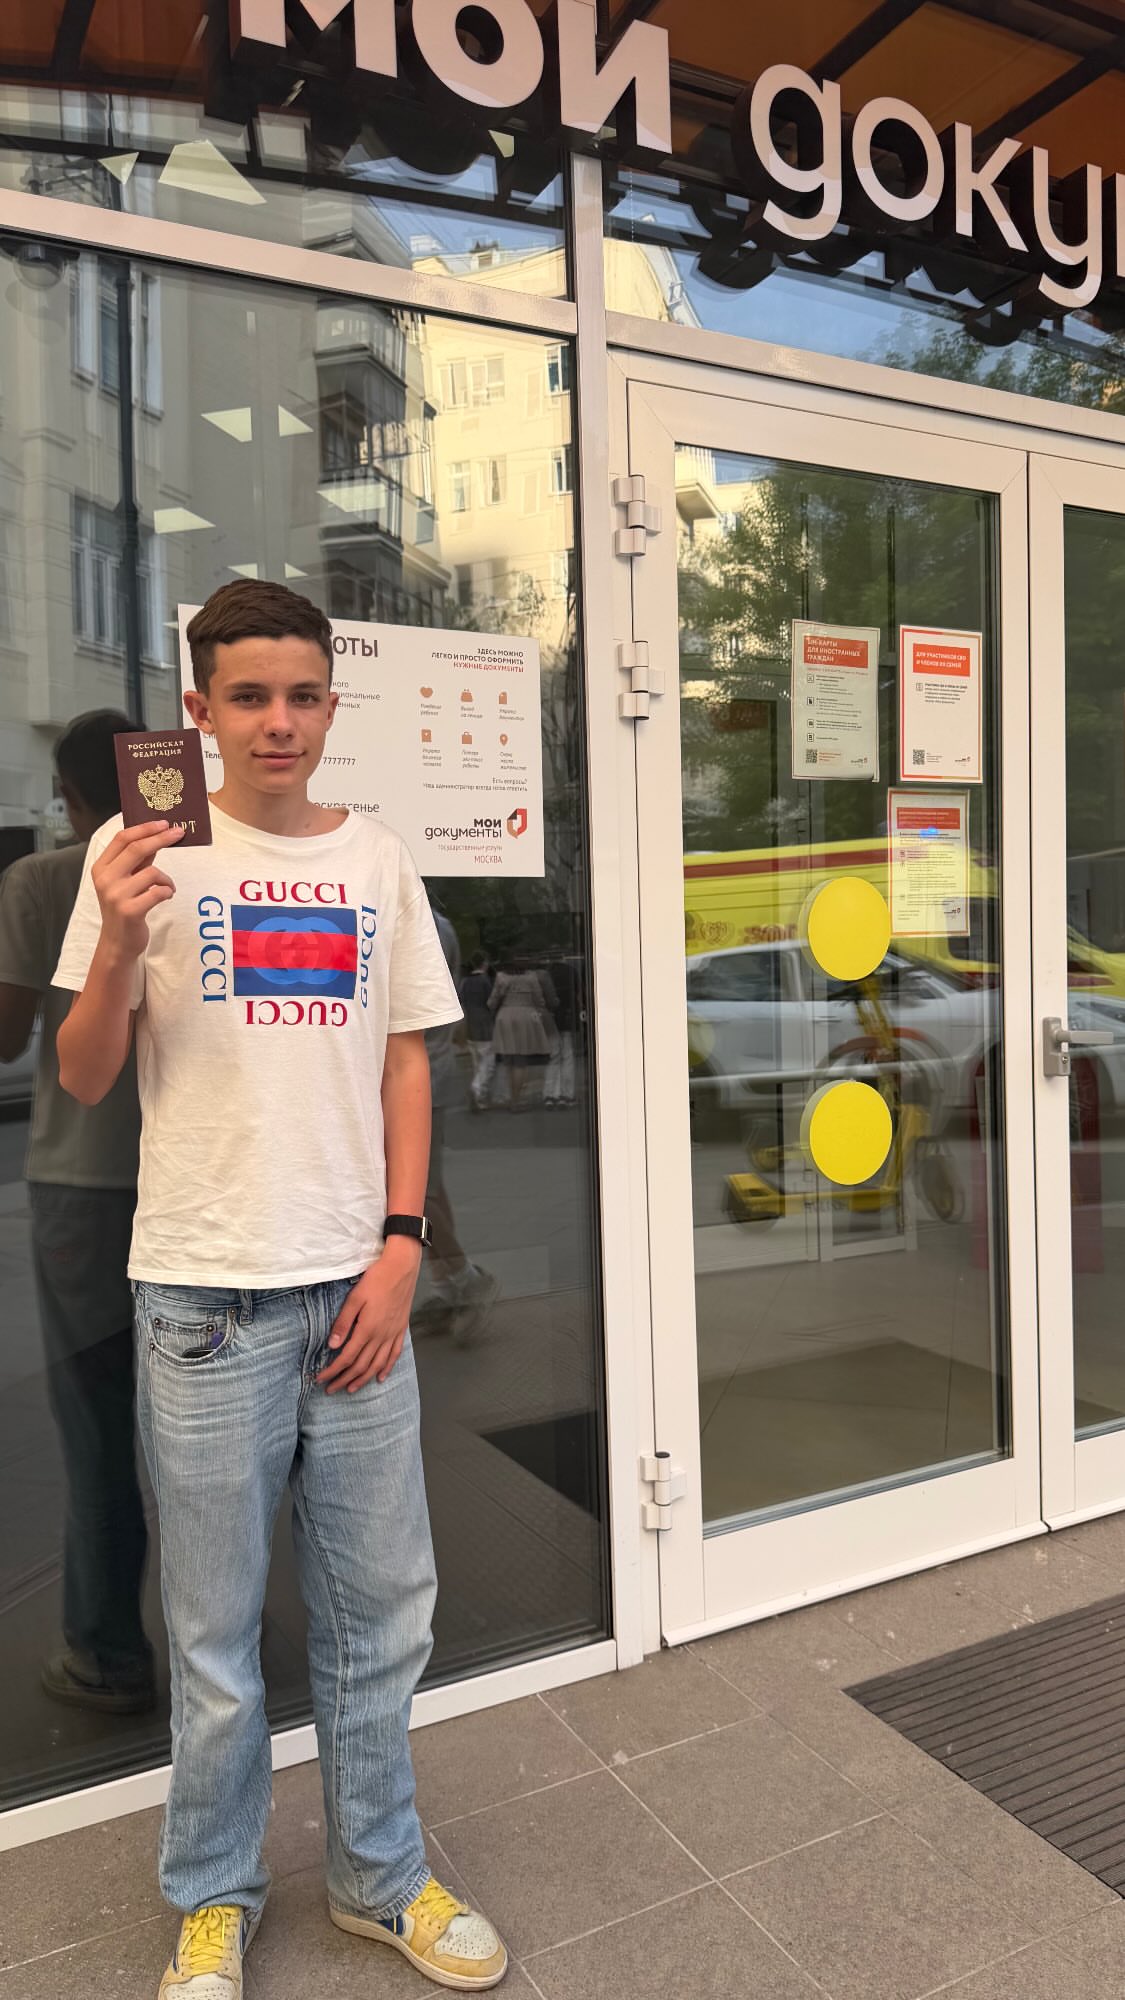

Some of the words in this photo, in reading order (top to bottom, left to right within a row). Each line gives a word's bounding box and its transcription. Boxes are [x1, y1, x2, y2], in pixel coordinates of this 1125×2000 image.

[750, 64, 1125, 308] доку
[487, 657, 524, 665] ОФОРМИТЬ
[483, 664, 524, 672] ДОКУМЕНТЫ
[127, 740, 184, 751] РОССИЙСКАЯ
[132, 748, 182, 758] ФЕДЕРАЦИЯ
[473, 818, 502, 828] мои
[424, 827, 502, 841] документы
[474, 855, 503, 864] МОСКВА
[239, 879, 348, 905] GUCCI
[197, 895, 227, 1003] GUCCI
[360, 904, 377, 1008] GUCCI
[245, 1000, 348, 1027] GUCCI
